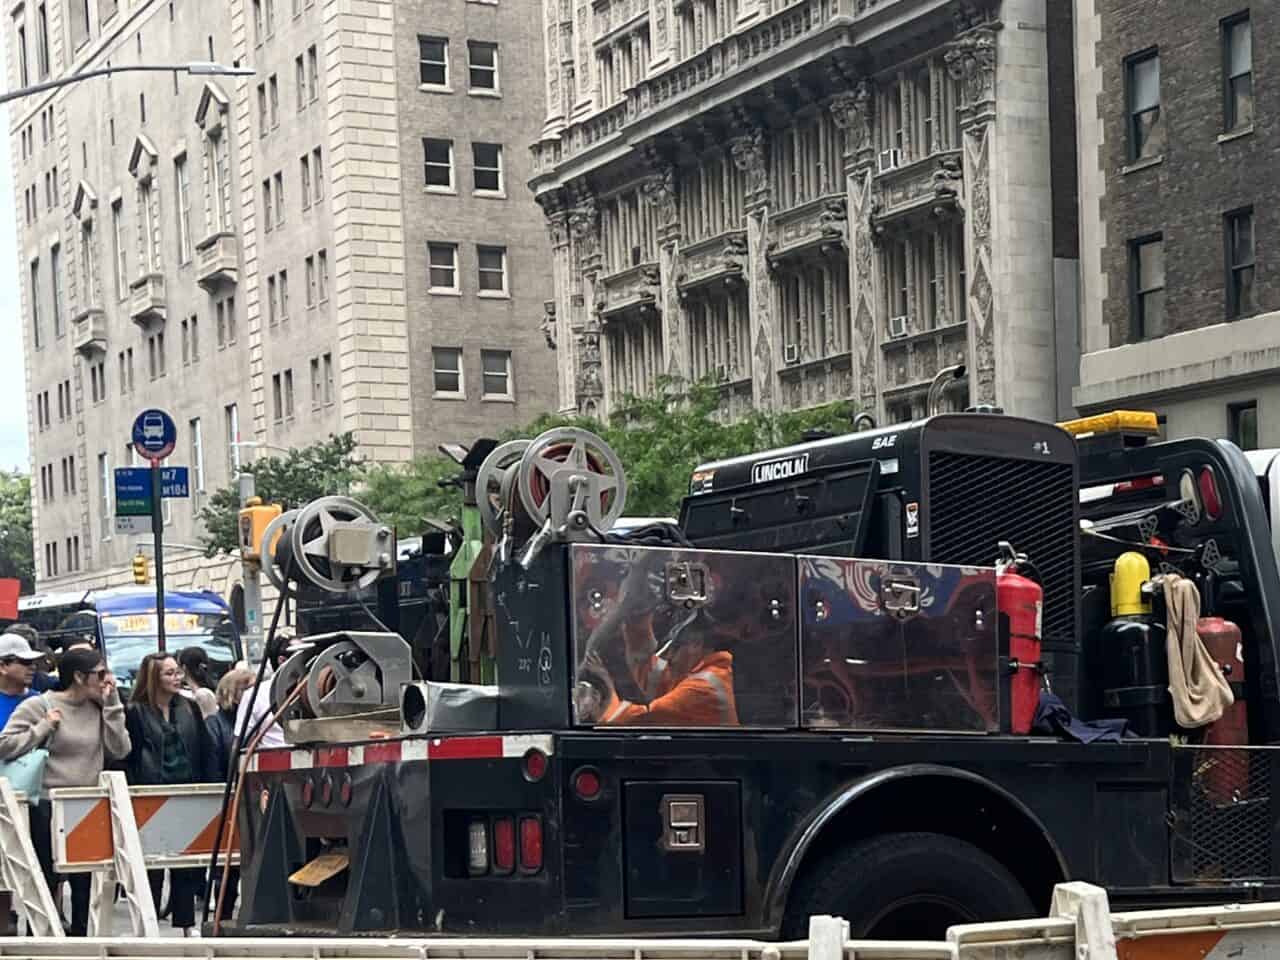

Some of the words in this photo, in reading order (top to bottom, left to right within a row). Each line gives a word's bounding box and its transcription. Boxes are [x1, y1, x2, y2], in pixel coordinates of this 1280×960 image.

[872, 434, 898, 450] SAE
[162, 469, 177, 480] M7
[754, 458, 805, 484] LINCOLN
[162, 483, 187, 495] M104
